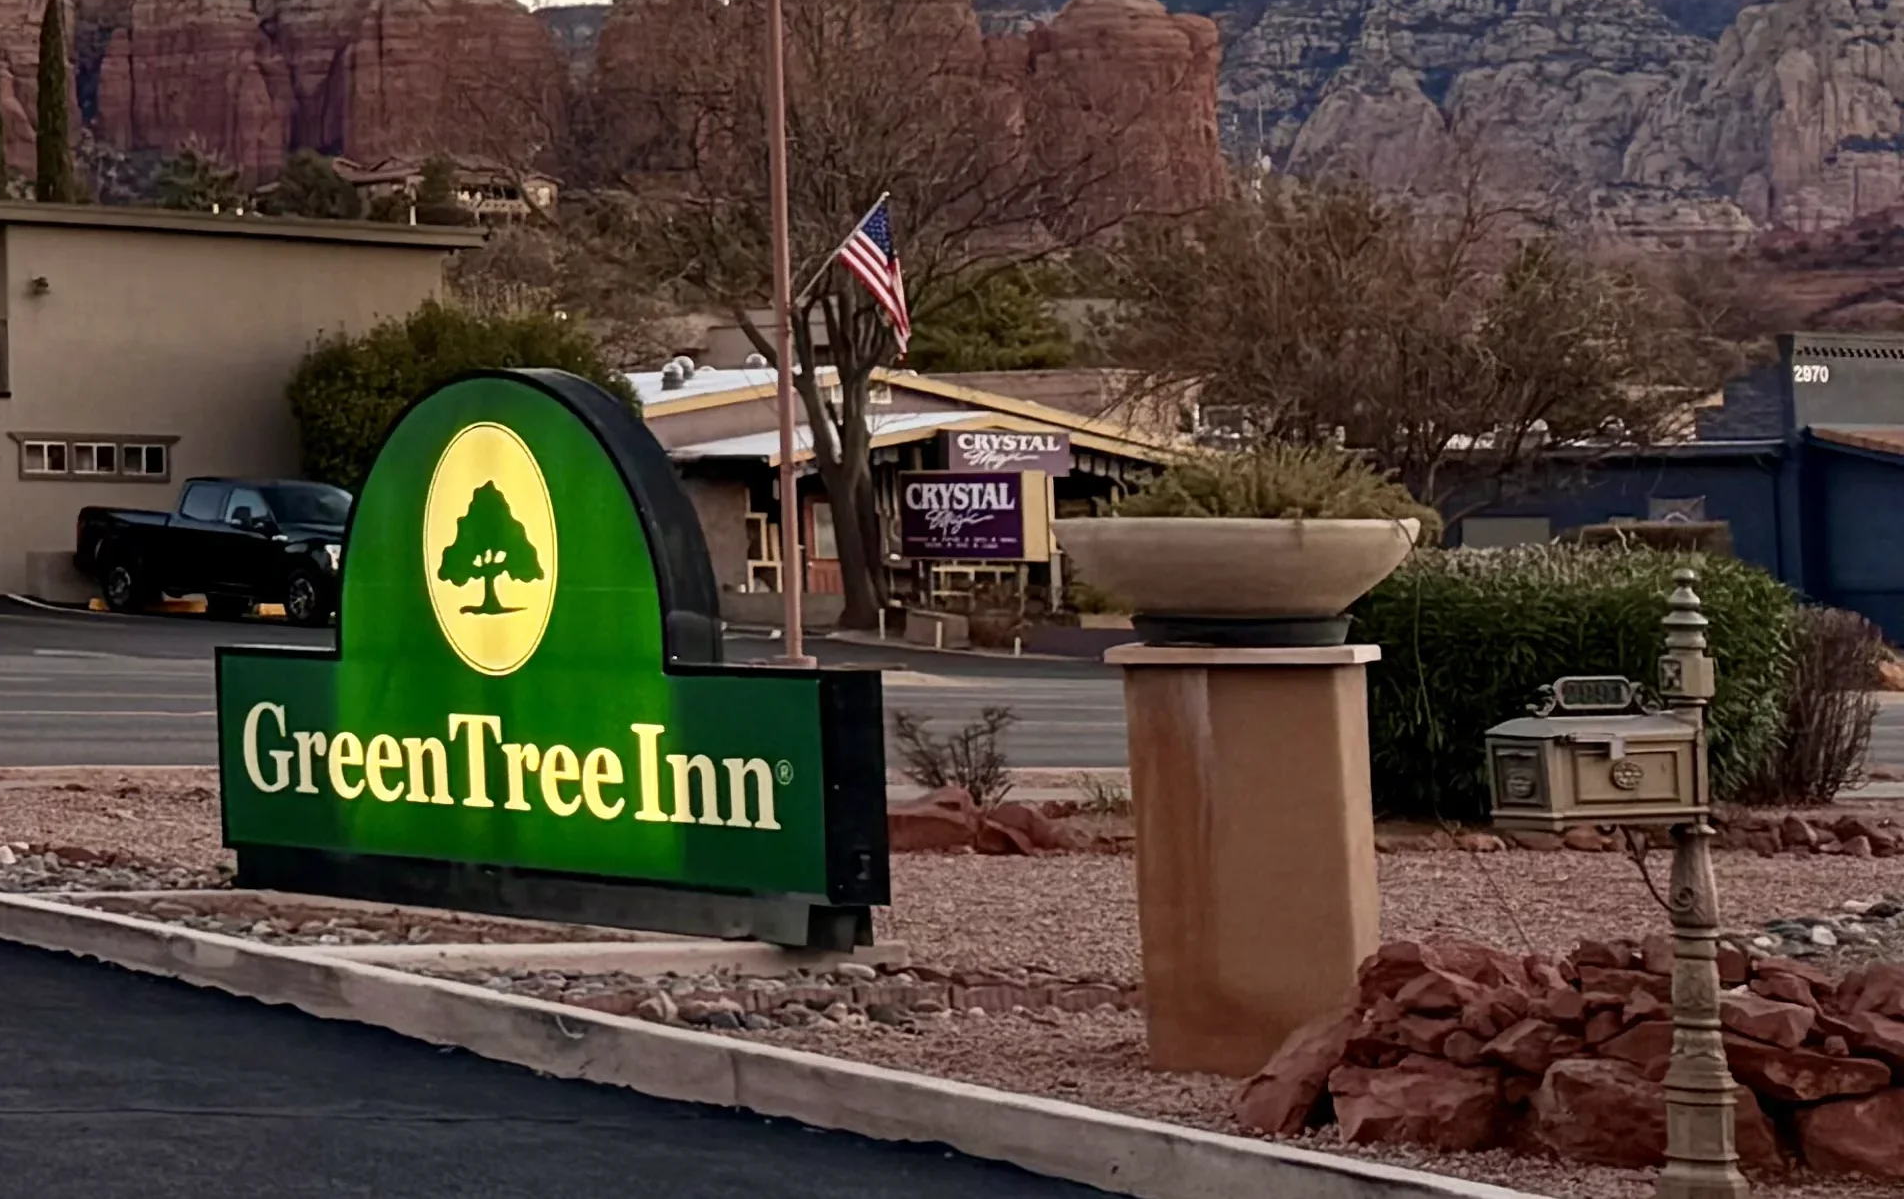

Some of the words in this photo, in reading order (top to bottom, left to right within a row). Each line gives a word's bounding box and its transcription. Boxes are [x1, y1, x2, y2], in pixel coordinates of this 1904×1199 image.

[1793, 364, 1830, 383] 2970
[957, 433, 1061, 452] CRYSTAL
[905, 482, 1016, 511] CRYSTAL
